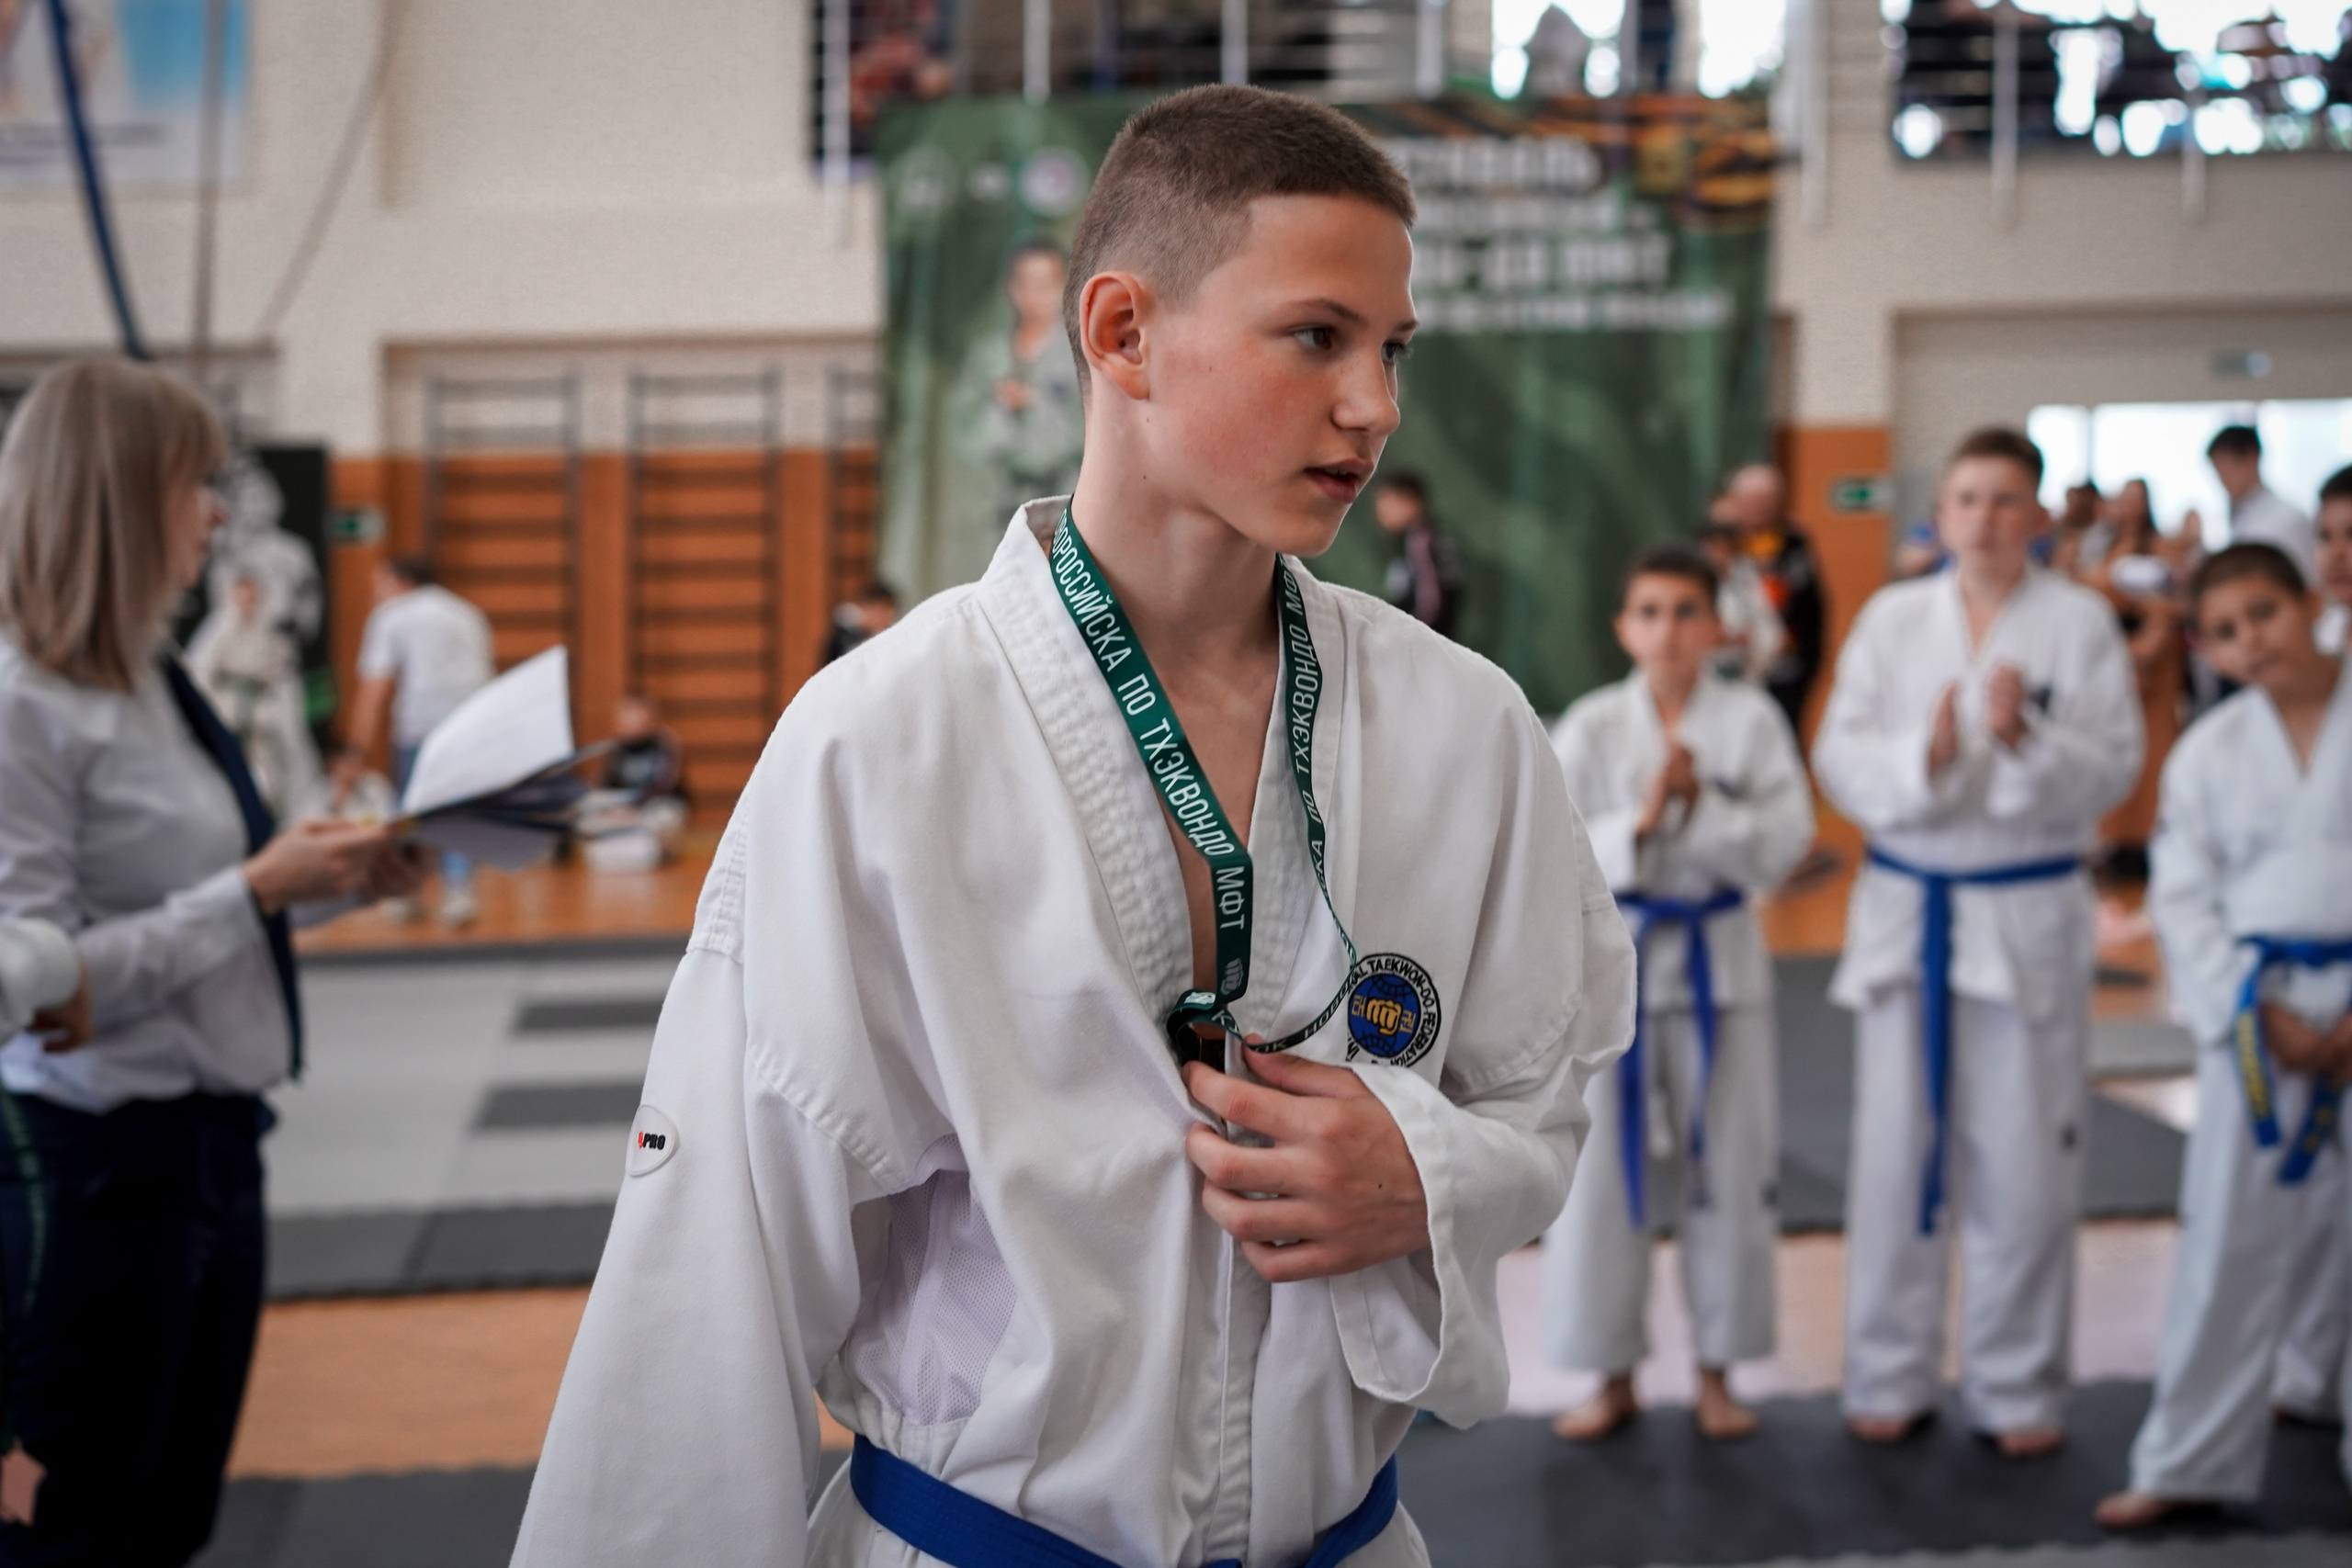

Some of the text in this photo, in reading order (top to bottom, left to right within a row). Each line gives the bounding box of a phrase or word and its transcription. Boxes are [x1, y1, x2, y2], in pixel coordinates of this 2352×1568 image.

[1289, 623, 1318, 774] ТХЭКВОНДО
[1117, 673, 1156, 716] ПО
[1139, 717, 1235, 857] ТХЭКВОНДО
[1216, 866, 1245, 930] МФТ
[1302, 789, 1322, 824] ПО
